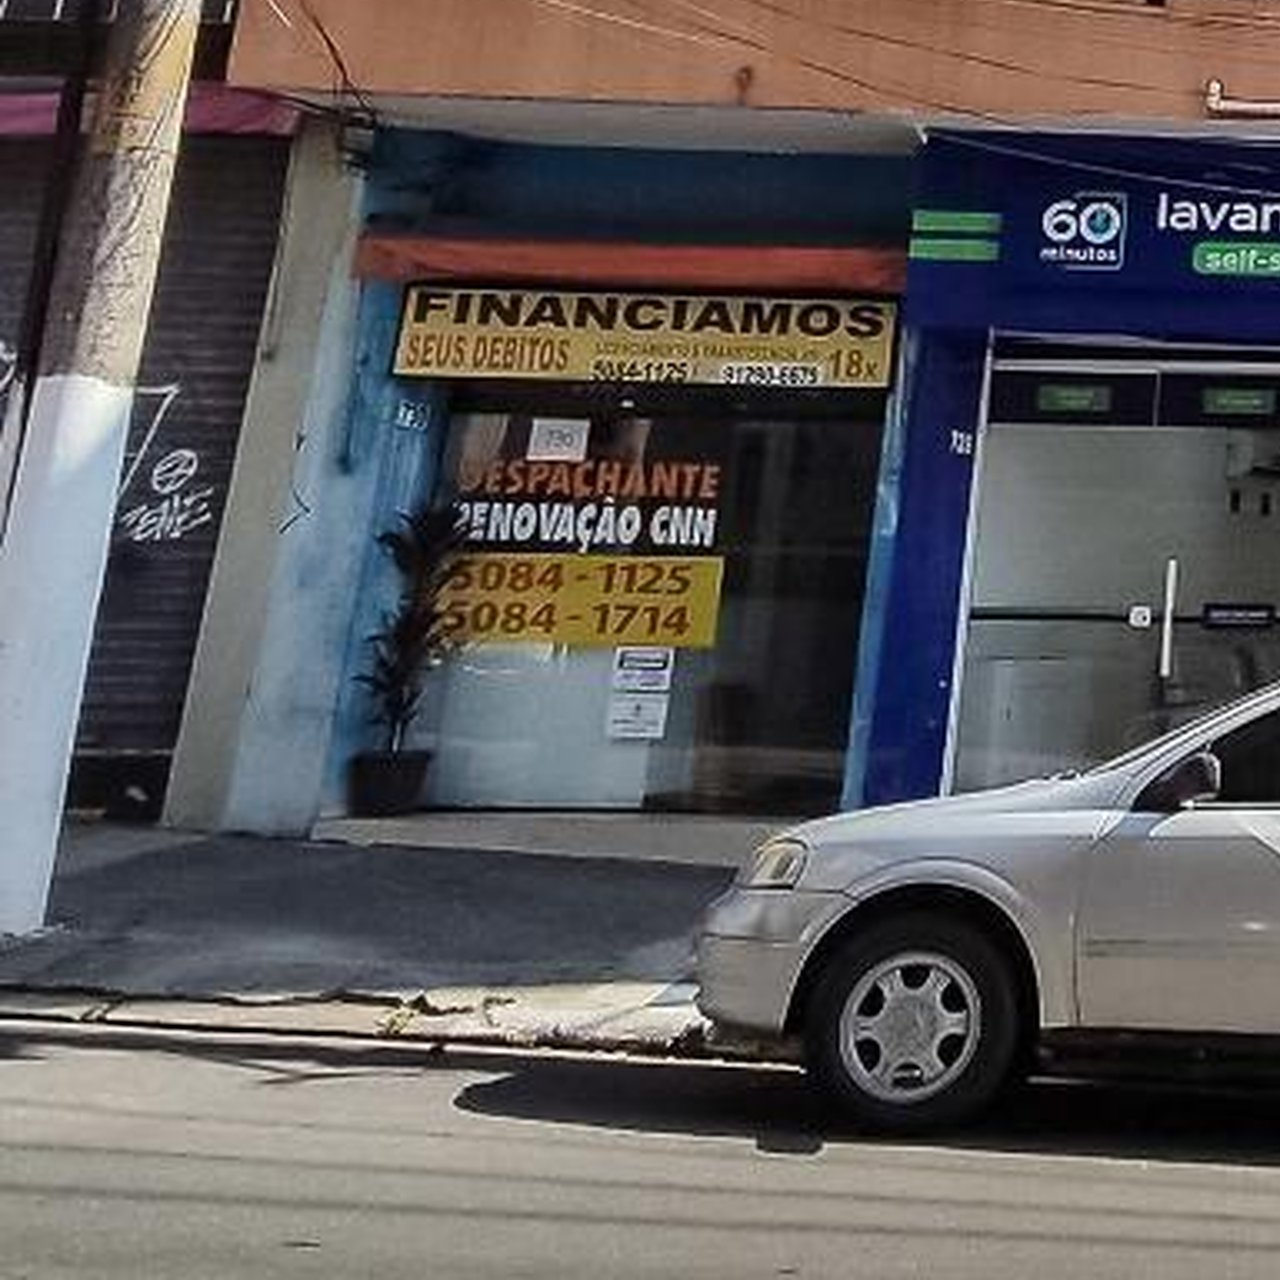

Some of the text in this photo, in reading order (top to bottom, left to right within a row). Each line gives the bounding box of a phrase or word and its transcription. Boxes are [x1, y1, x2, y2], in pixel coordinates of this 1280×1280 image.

[1042, 200, 1121, 245] 60
[1040, 246, 1117, 262] minutos
[412, 292, 884, 337] FINANCIAMOS
[406, 332, 466, 369] SEUS
[457, 458, 722, 498] DESPACHANTE
